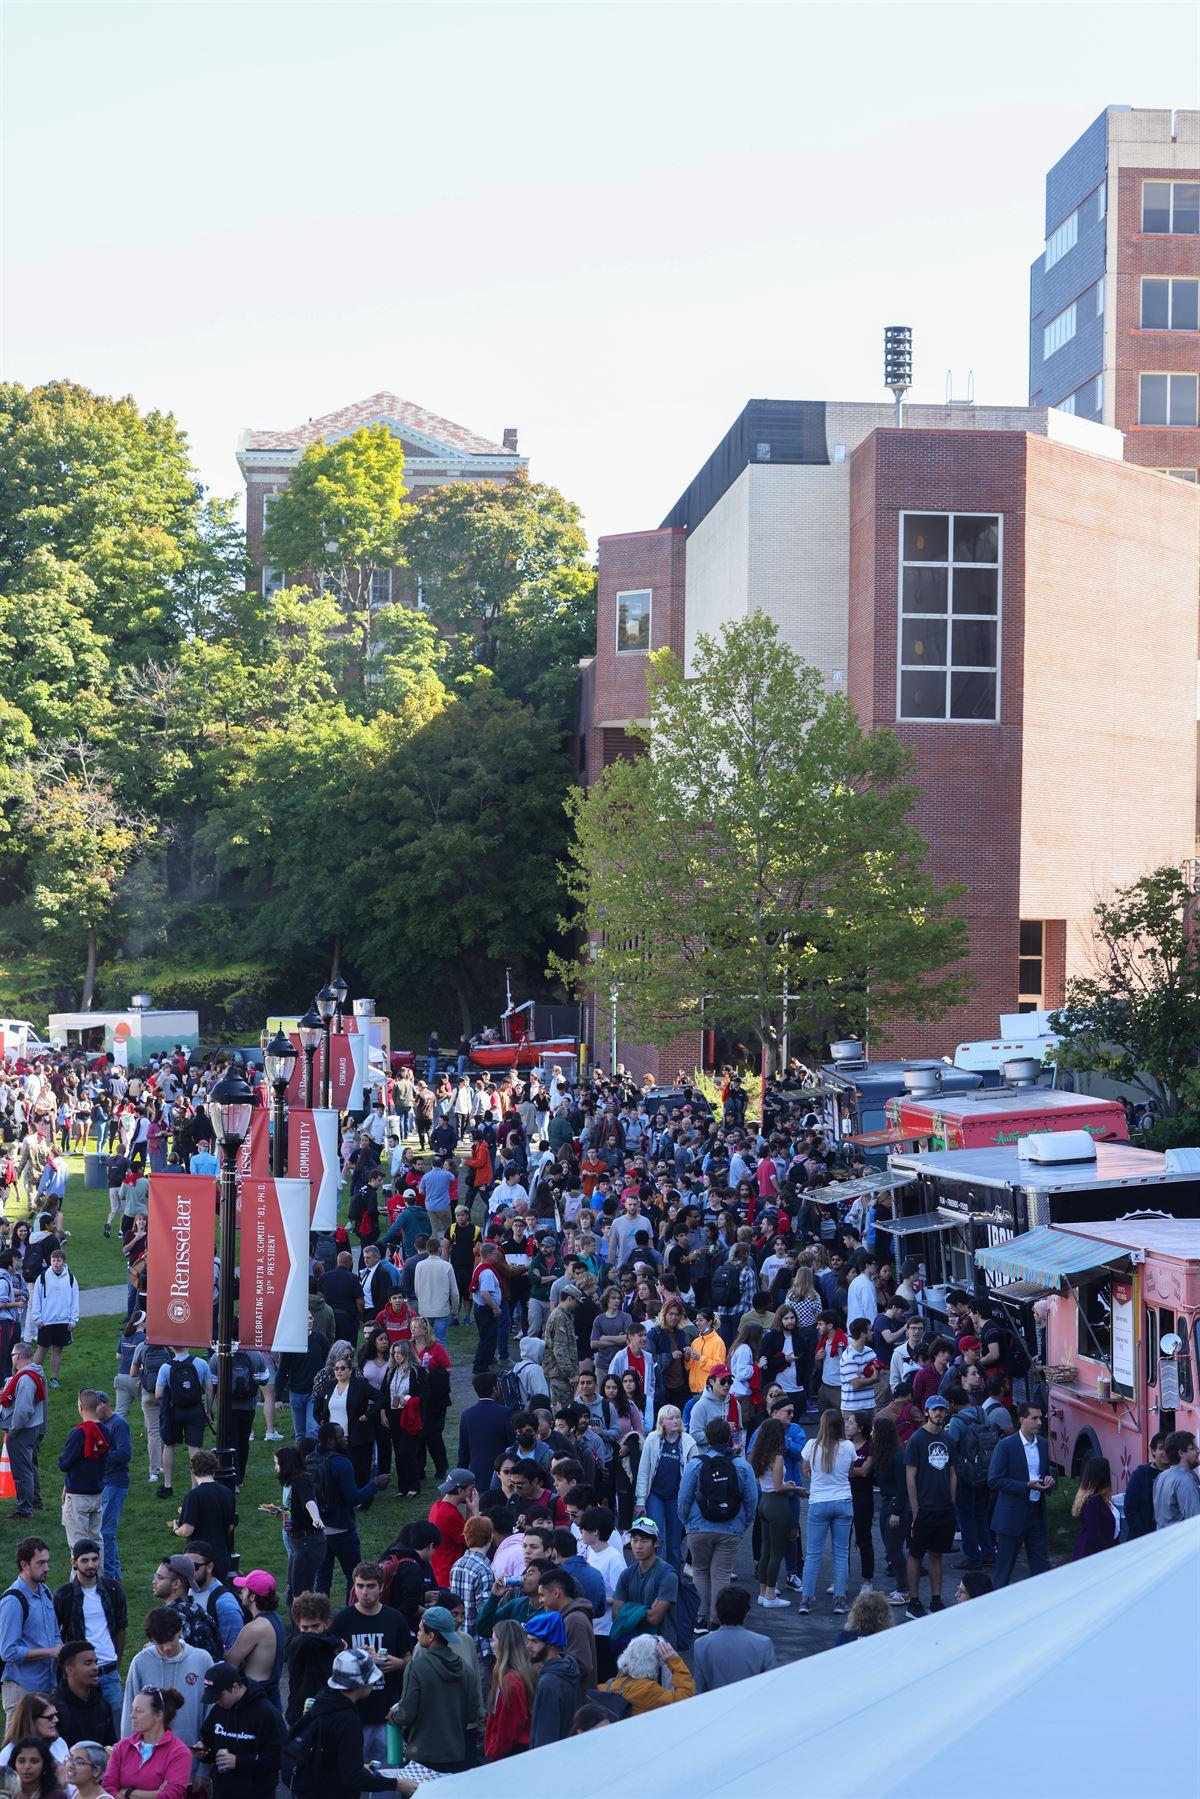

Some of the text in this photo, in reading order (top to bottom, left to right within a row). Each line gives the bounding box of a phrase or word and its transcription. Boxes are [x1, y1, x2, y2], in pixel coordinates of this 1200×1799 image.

[300, 1121, 311, 1178] COMMUNITY
[257, 1182, 266, 1203] PH.D.
[170, 1195, 191, 1297] Rensselaer
[257, 1221, 265, 1253] SCHMIDT
[267, 1233, 276, 1276] PRESIDENT
[257, 1256, 264, 1264] A.
[256, 1266, 265, 1295] MARTIN
[255, 1297, 264, 1347] CELEBRATING
